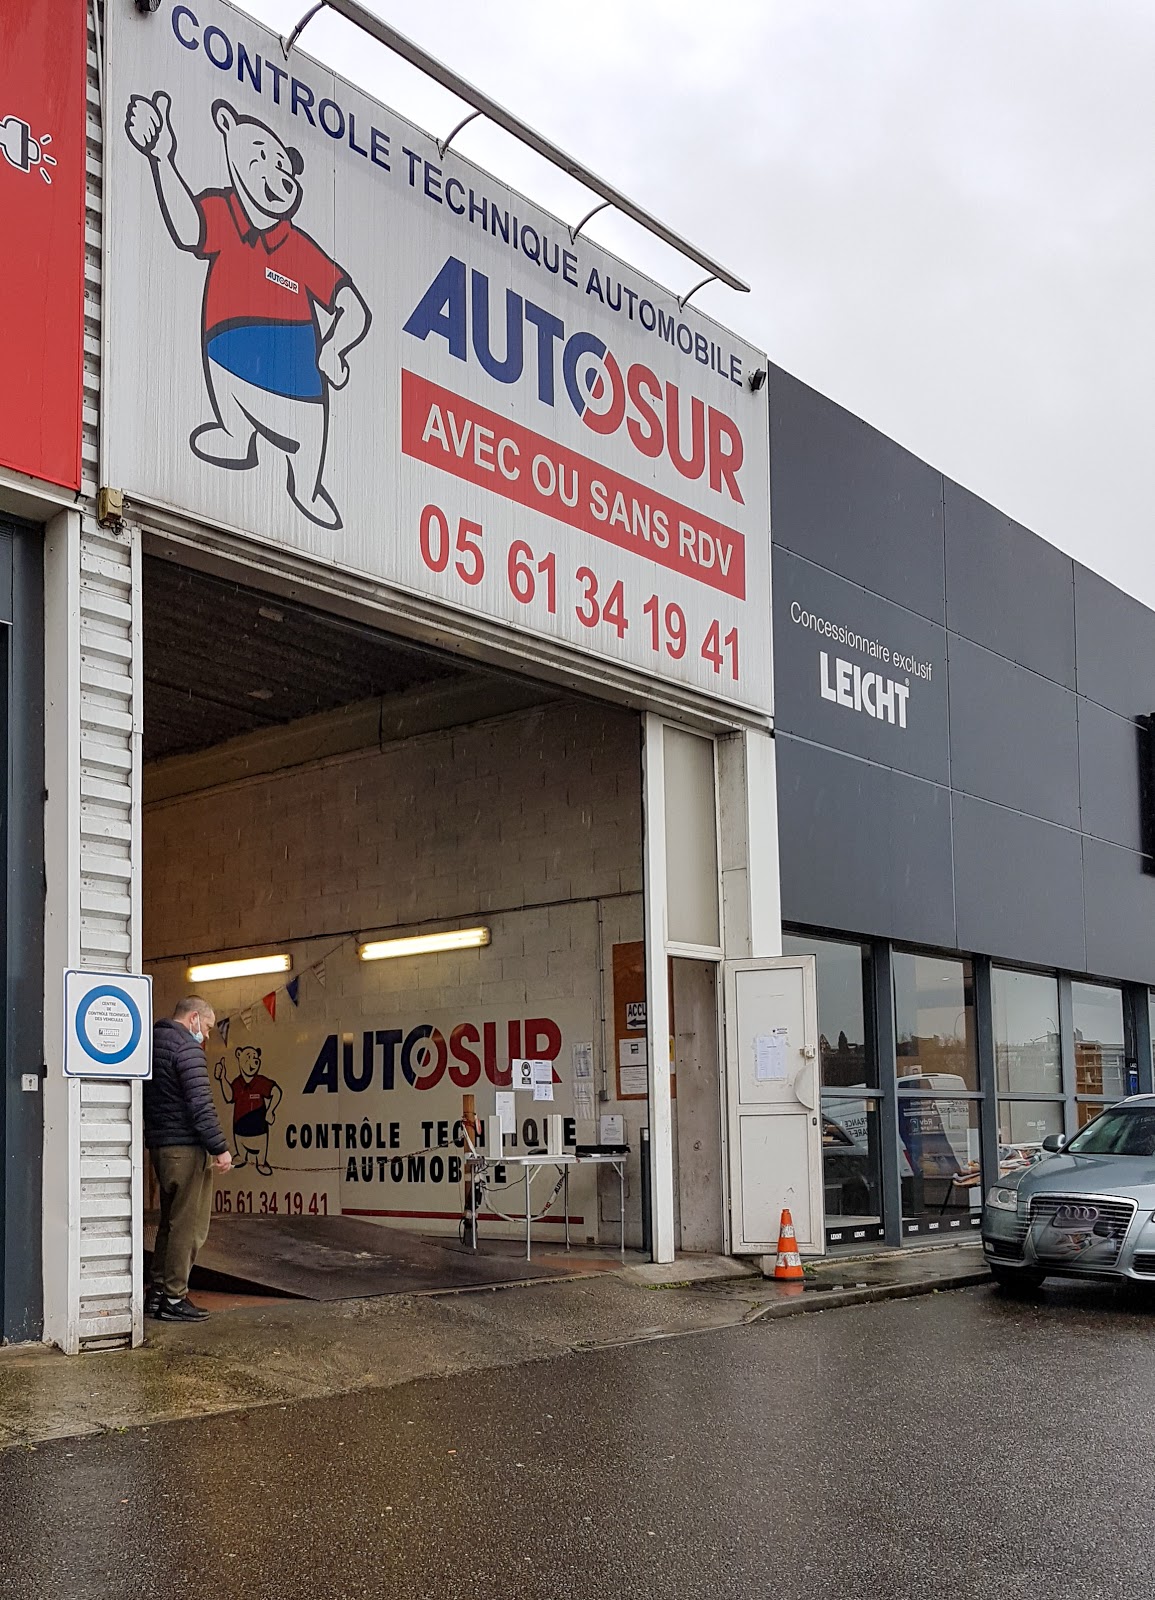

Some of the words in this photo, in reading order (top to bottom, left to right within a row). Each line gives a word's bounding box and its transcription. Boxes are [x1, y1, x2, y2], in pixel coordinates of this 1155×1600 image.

[171, 5, 390, 172] CONTROLE
[402, 146, 578, 287] TECHNIQUE
[586, 268, 743, 387] AUTOMOBILE
[267, 271, 298, 291] AUTOSUR
[402, 255, 746, 505] AUTOSUR
[421, 403, 521, 481] AVEC
[531, 454, 579, 507] OU
[589, 480, 669, 549] SANS
[678, 521, 733, 577] RDV
[419, 504, 485, 586] 05
[507, 539, 556, 614] 61
[575, 566, 629, 640] 34
[643, 594, 687, 660] 19
[701, 619, 739, 681] 41
[790, 601, 890, 663] Concessionnaire
[893, 651, 932, 681] exclusif
[819, 650, 910, 729] LEICHT
[302, 1017, 563, 1094] AUTOSUR
[285, 1116, 400, 1149] CONTRÔLE
[345, 1156, 507, 1184] AUTOMOBE
[215, 1190, 232, 1213] 05
[236, 1191, 253, 1214] 61
[259, 1191, 279, 1214] 34
[284, 1192, 303, 1215] 19
[308, 1192, 328, 1216] 41
